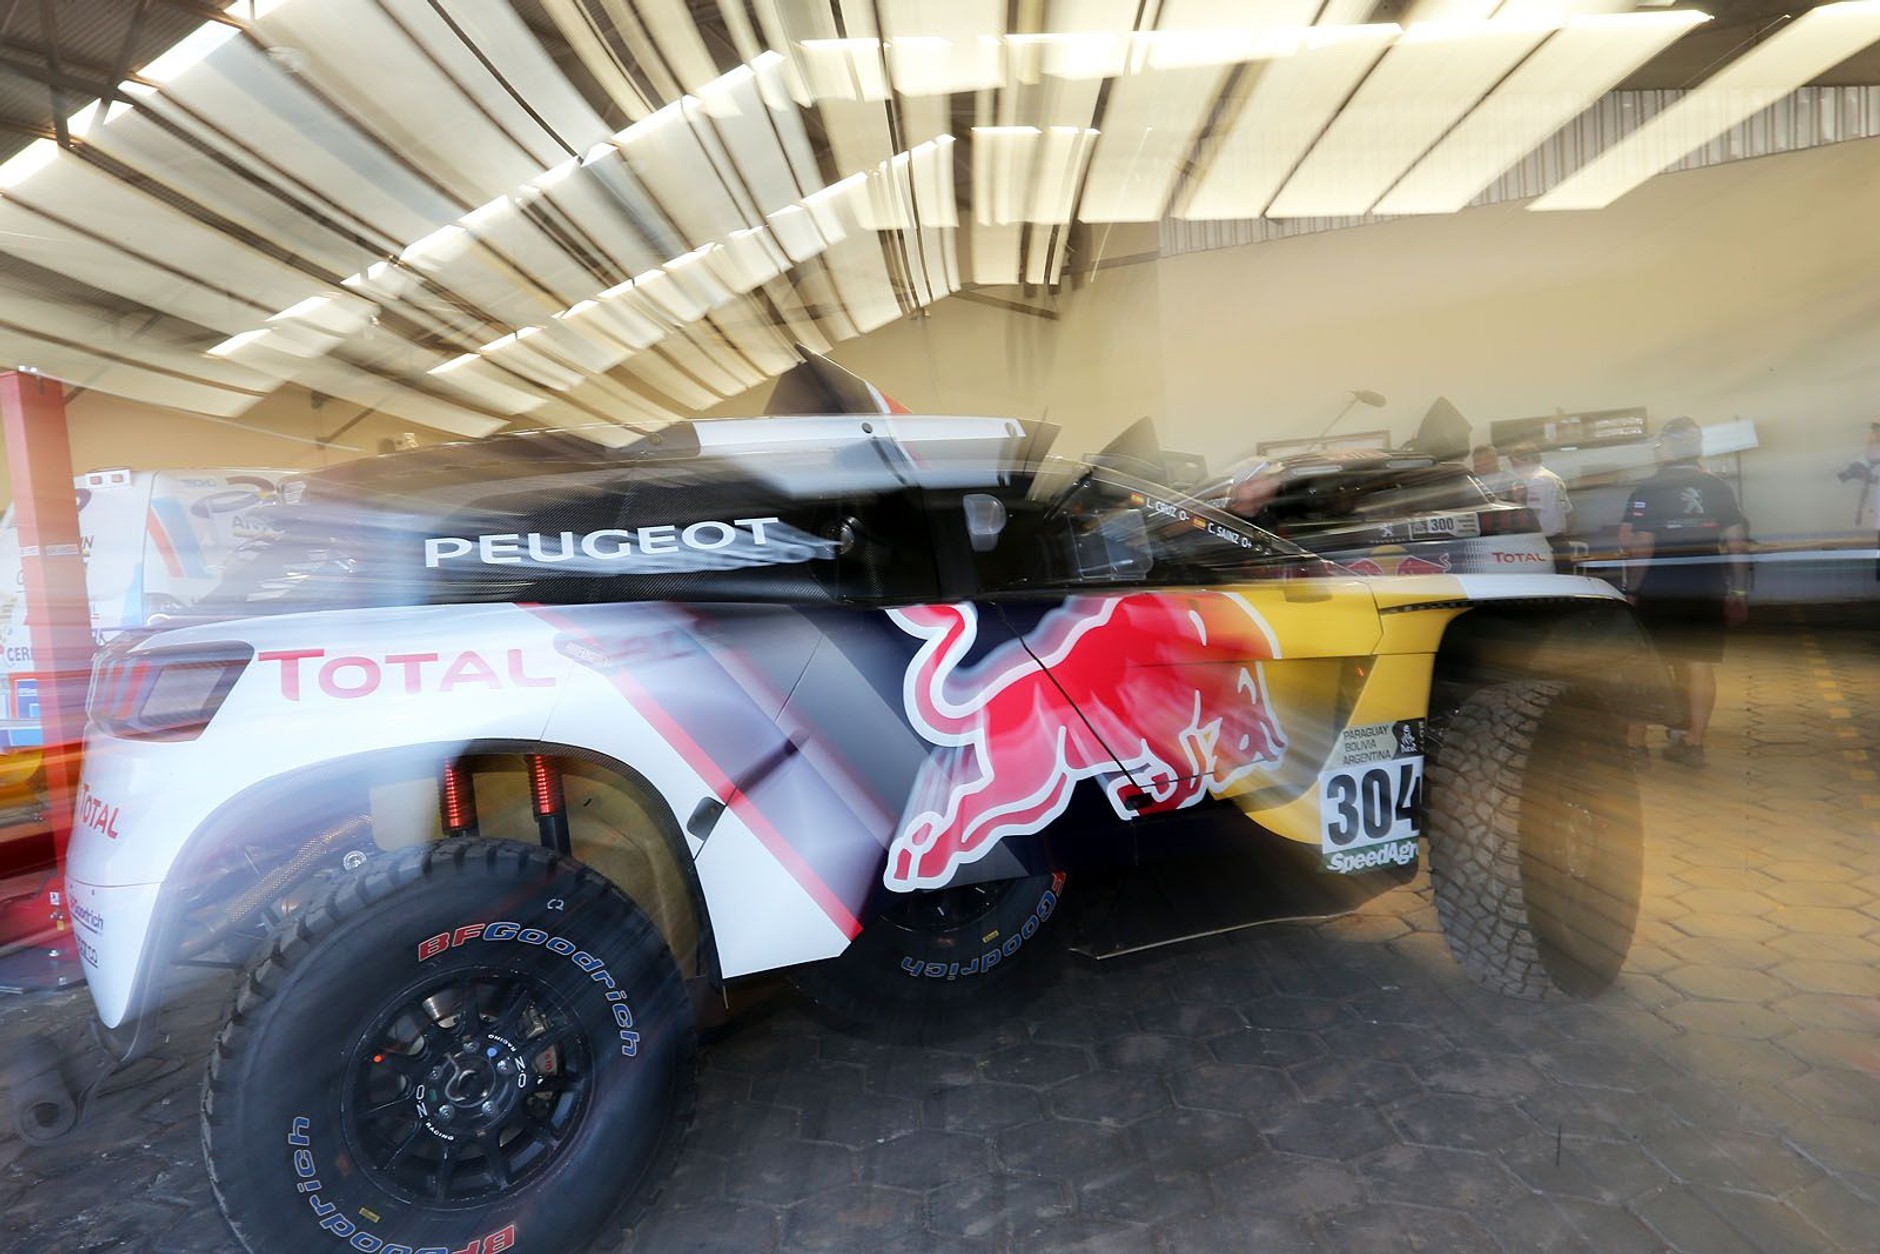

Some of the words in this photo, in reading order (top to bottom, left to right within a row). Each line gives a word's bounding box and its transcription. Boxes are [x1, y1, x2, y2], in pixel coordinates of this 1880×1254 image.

[1216, 527, 1240, 544] SAINZ
[1430, 517, 1454, 531] 300
[425, 517, 779, 568] PEUGEOT
[1491, 551, 1547, 564] TOTAL
[257, 648, 557, 701] TOTAL
[1343, 725, 1389, 739] PARAGUAY
[1344, 738, 1377, 753] BOLIVIA
[1342, 749, 1391, 765] ARGENTINA
[80, 783, 119, 840] TOTAL
[1326, 763, 1422, 846] 304
[900, 871, 1067, 980] FGoodrich
[417, 922, 641, 1057] BFGoodrich
